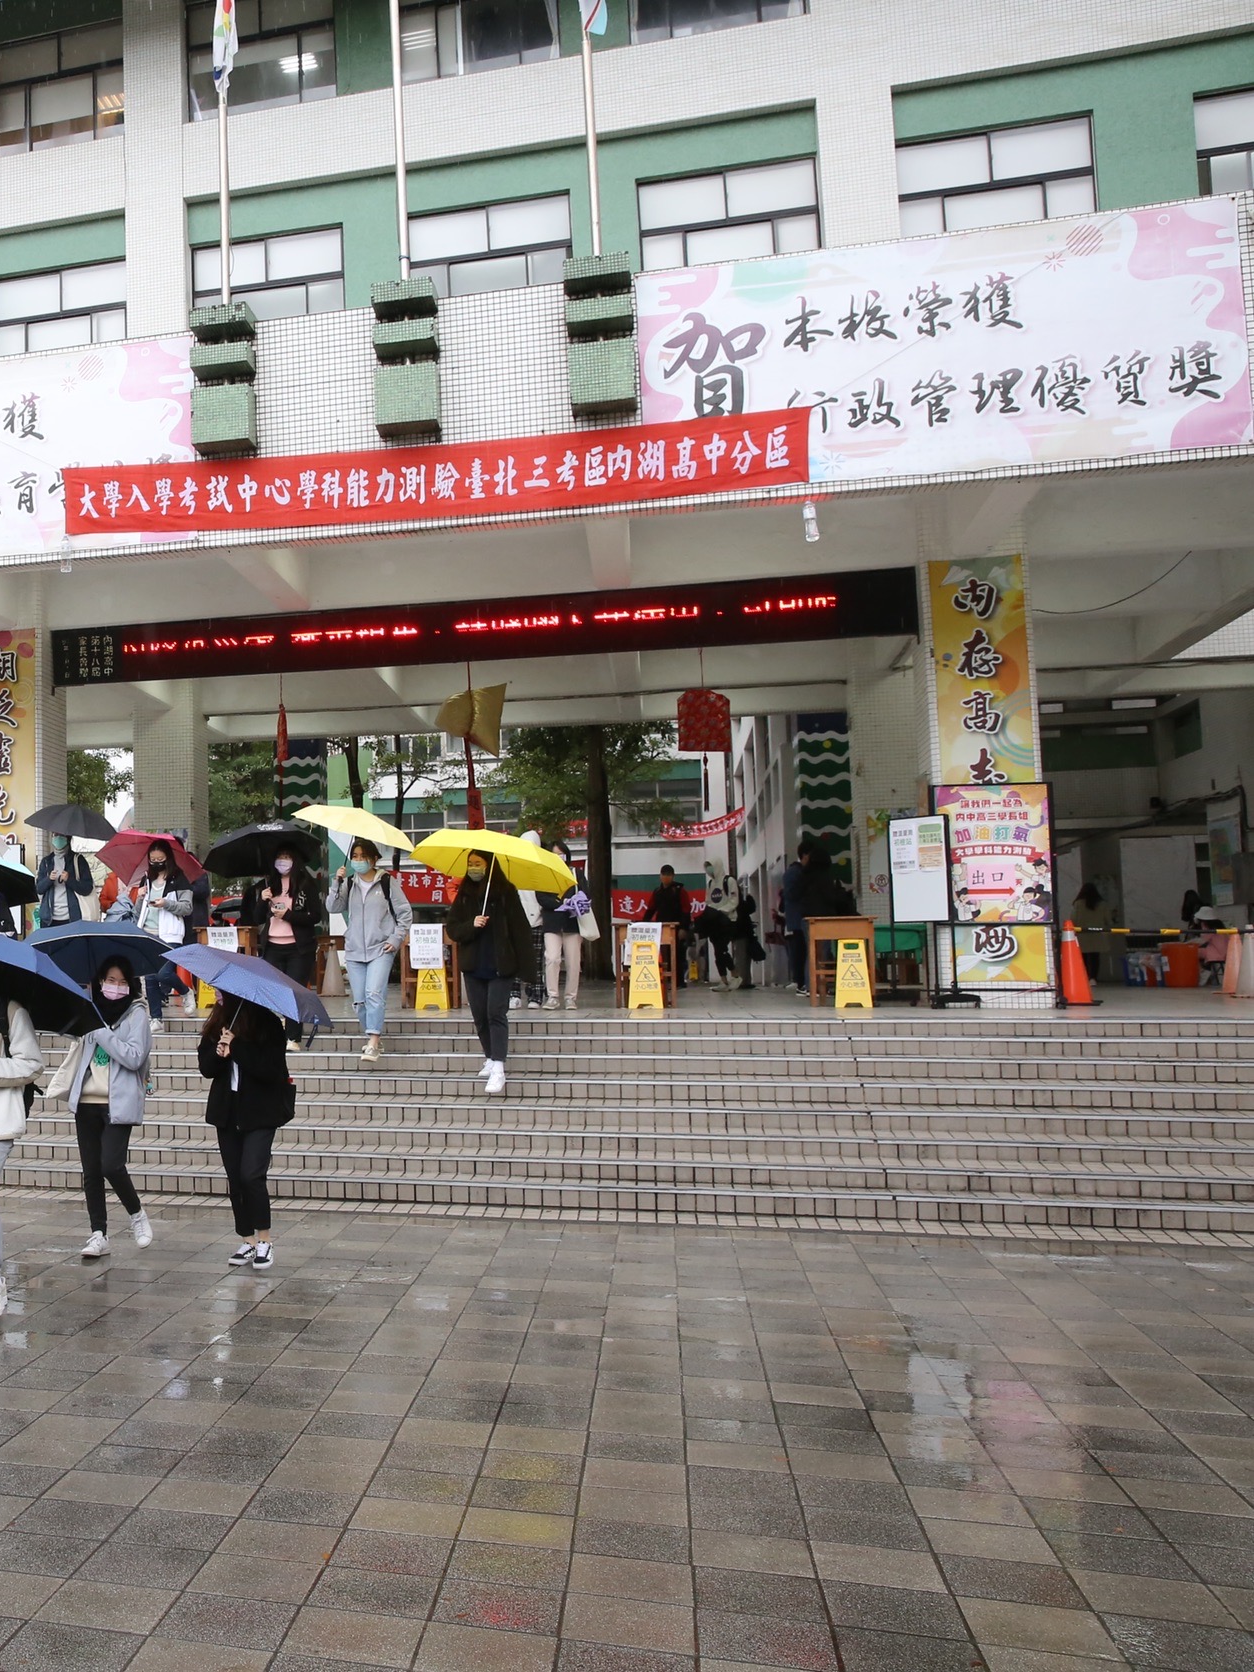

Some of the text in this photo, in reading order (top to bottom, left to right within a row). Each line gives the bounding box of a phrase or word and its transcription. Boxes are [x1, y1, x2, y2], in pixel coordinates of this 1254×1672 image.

[783, 272, 1023, 351] 本校榮獲
[663, 312, 766, 416] 賀
[788, 341, 1224, 433] 行政管理優質獎
[961, 799, 1023, 808] 讓我們一起為
[955, 825, 1030, 843] 加油打氣
[972, 870, 1004, 885] 出口
